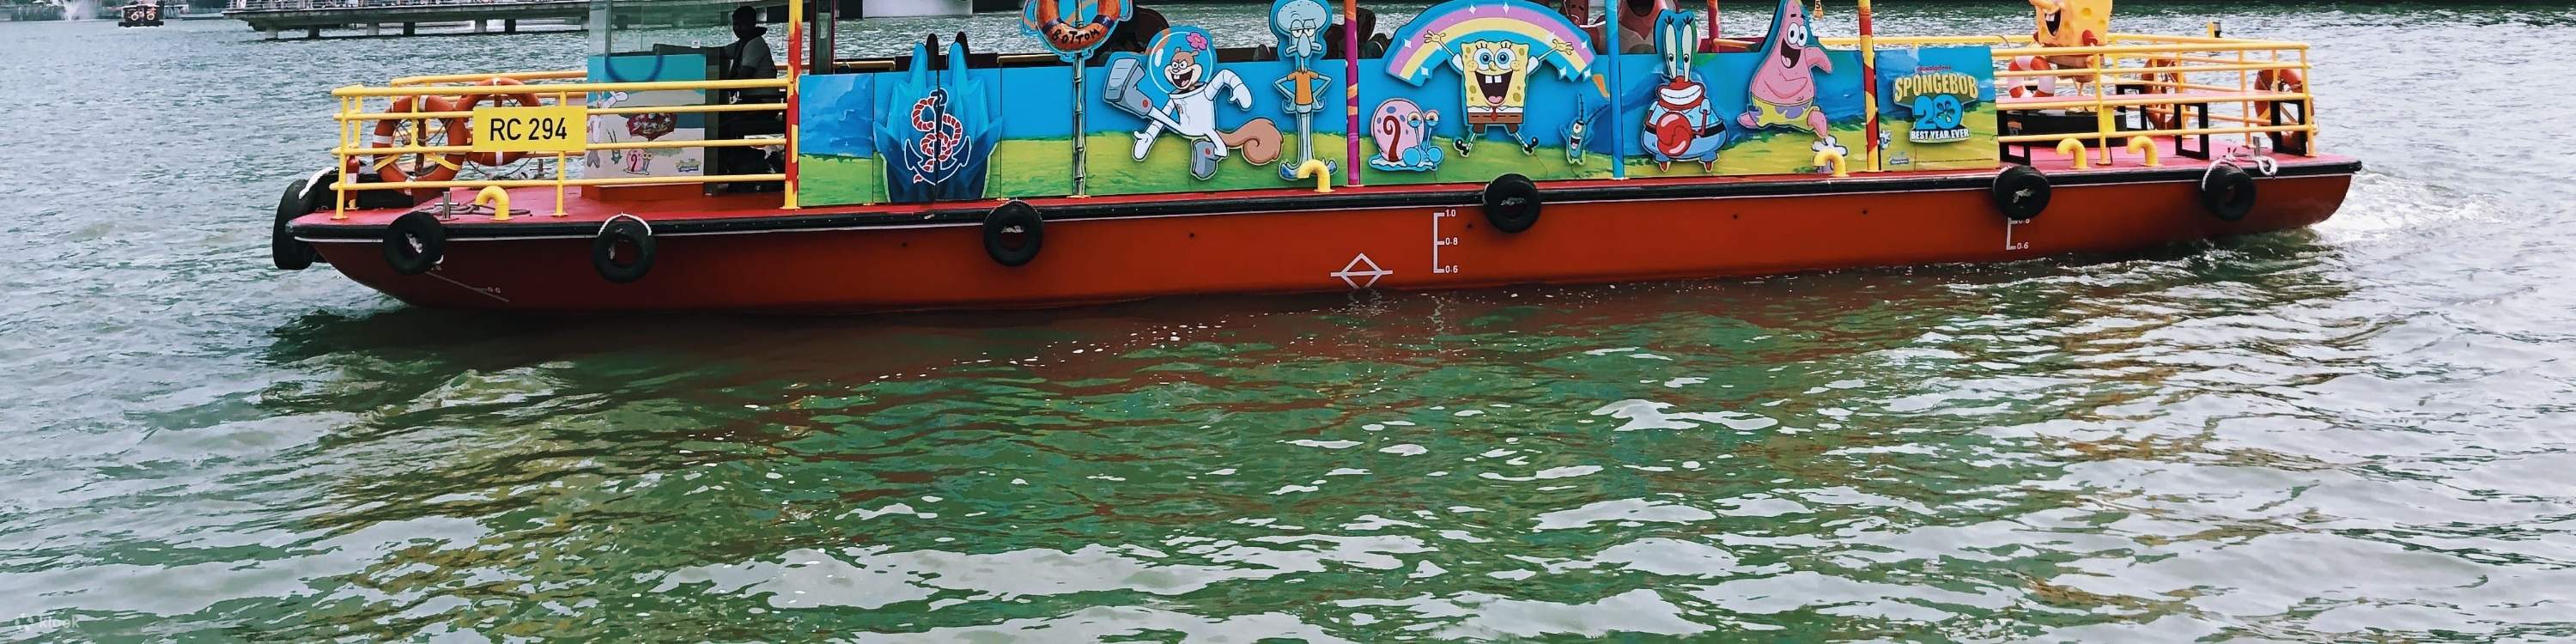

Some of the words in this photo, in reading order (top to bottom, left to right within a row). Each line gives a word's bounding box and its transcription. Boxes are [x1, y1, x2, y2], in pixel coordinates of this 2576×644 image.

[1052, 28, 1100, 44] BOTTOM
[1894, 72, 1978, 101] SPONGEBOB
[1914, 94, 1962, 130] 20
[489, 118, 522, 141] RC
[528, 117, 567, 140] 294
[1911, 131, 1929, 141] BEST
[1929, 130, 1949, 140] YEAR
[1950, 128, 1970, 139] EVER
[1445, 237, 1458, 246] 0.8
[2016, 241, 2029, 250] 0.6
[1445, 264, 1458, 273] 0.6
